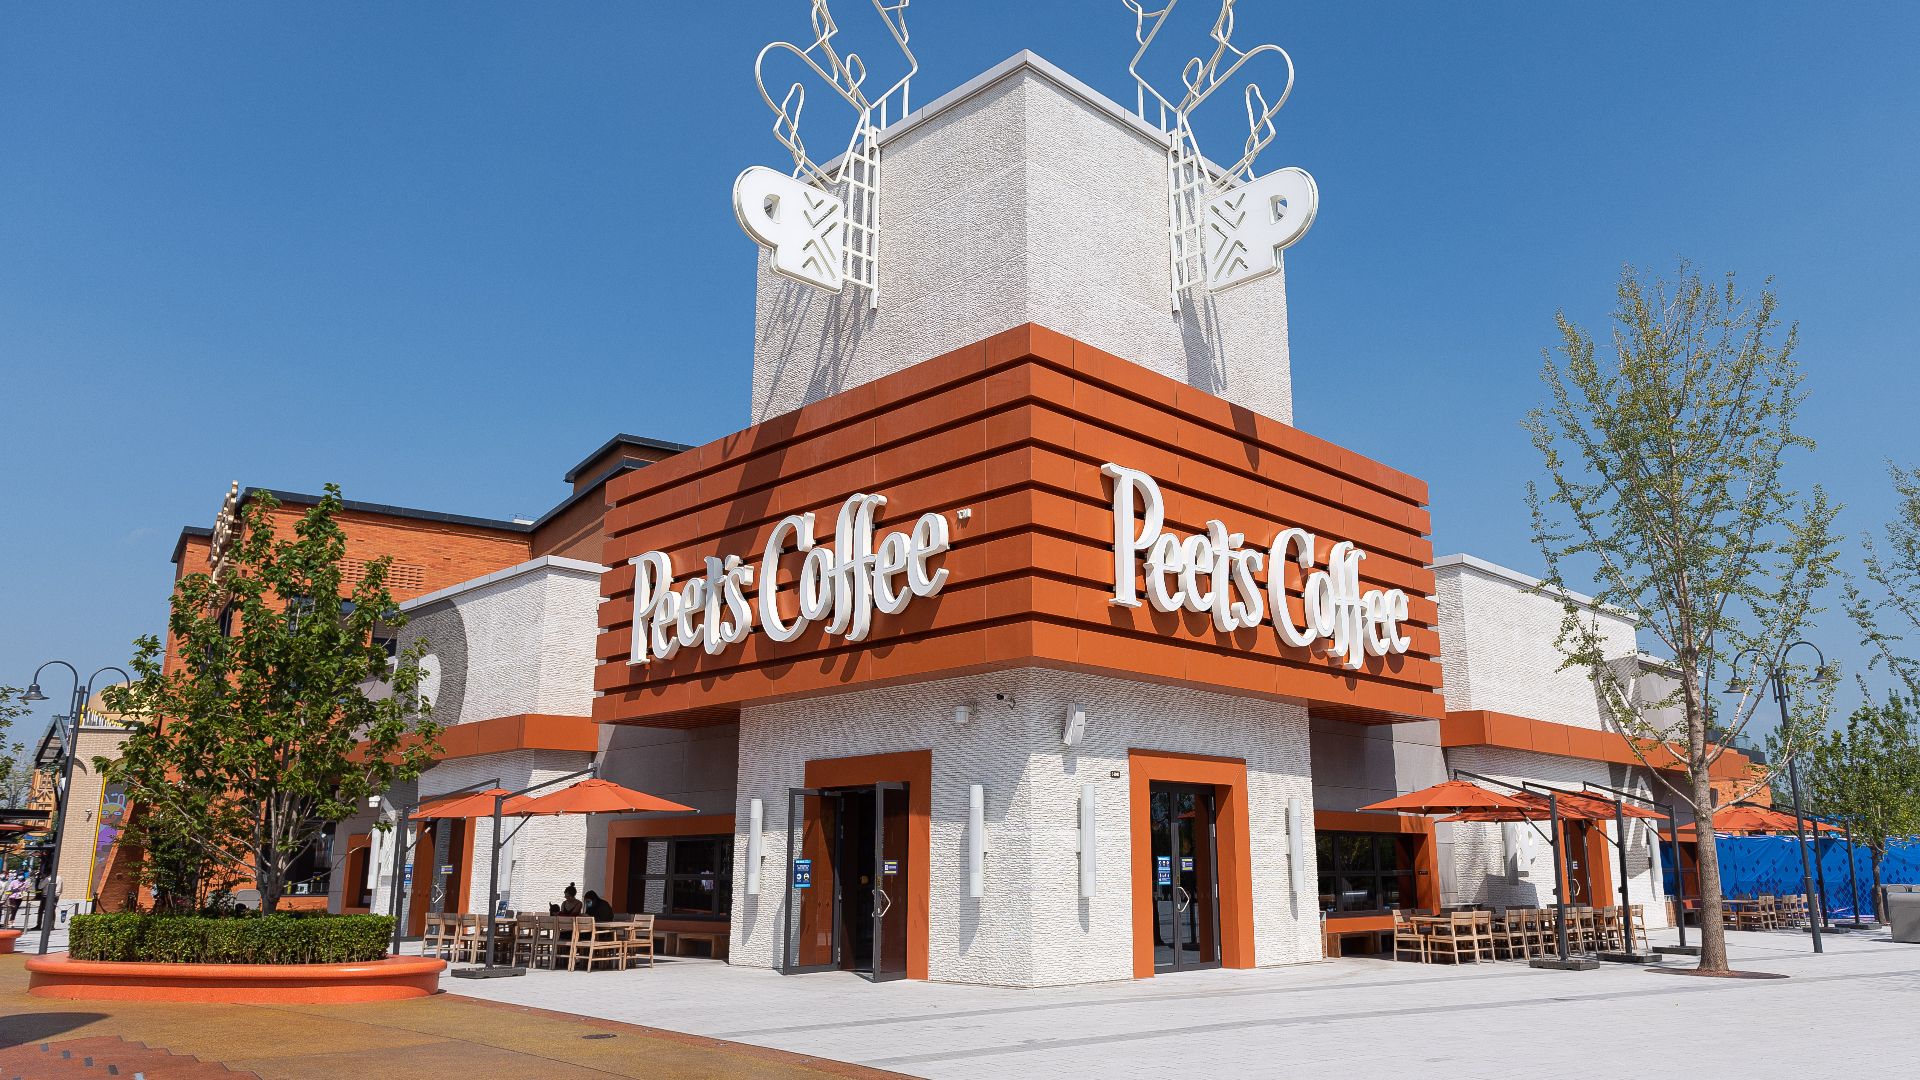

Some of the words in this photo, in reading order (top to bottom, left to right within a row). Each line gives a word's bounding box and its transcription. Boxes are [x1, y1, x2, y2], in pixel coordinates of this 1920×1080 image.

[626, 550, 754, 666] Peet's
[758, 492, 950, 643] Coffee
[1100, 462, 1265, 633] Peet's
[1267, 527, 1412, 670] Coffee
